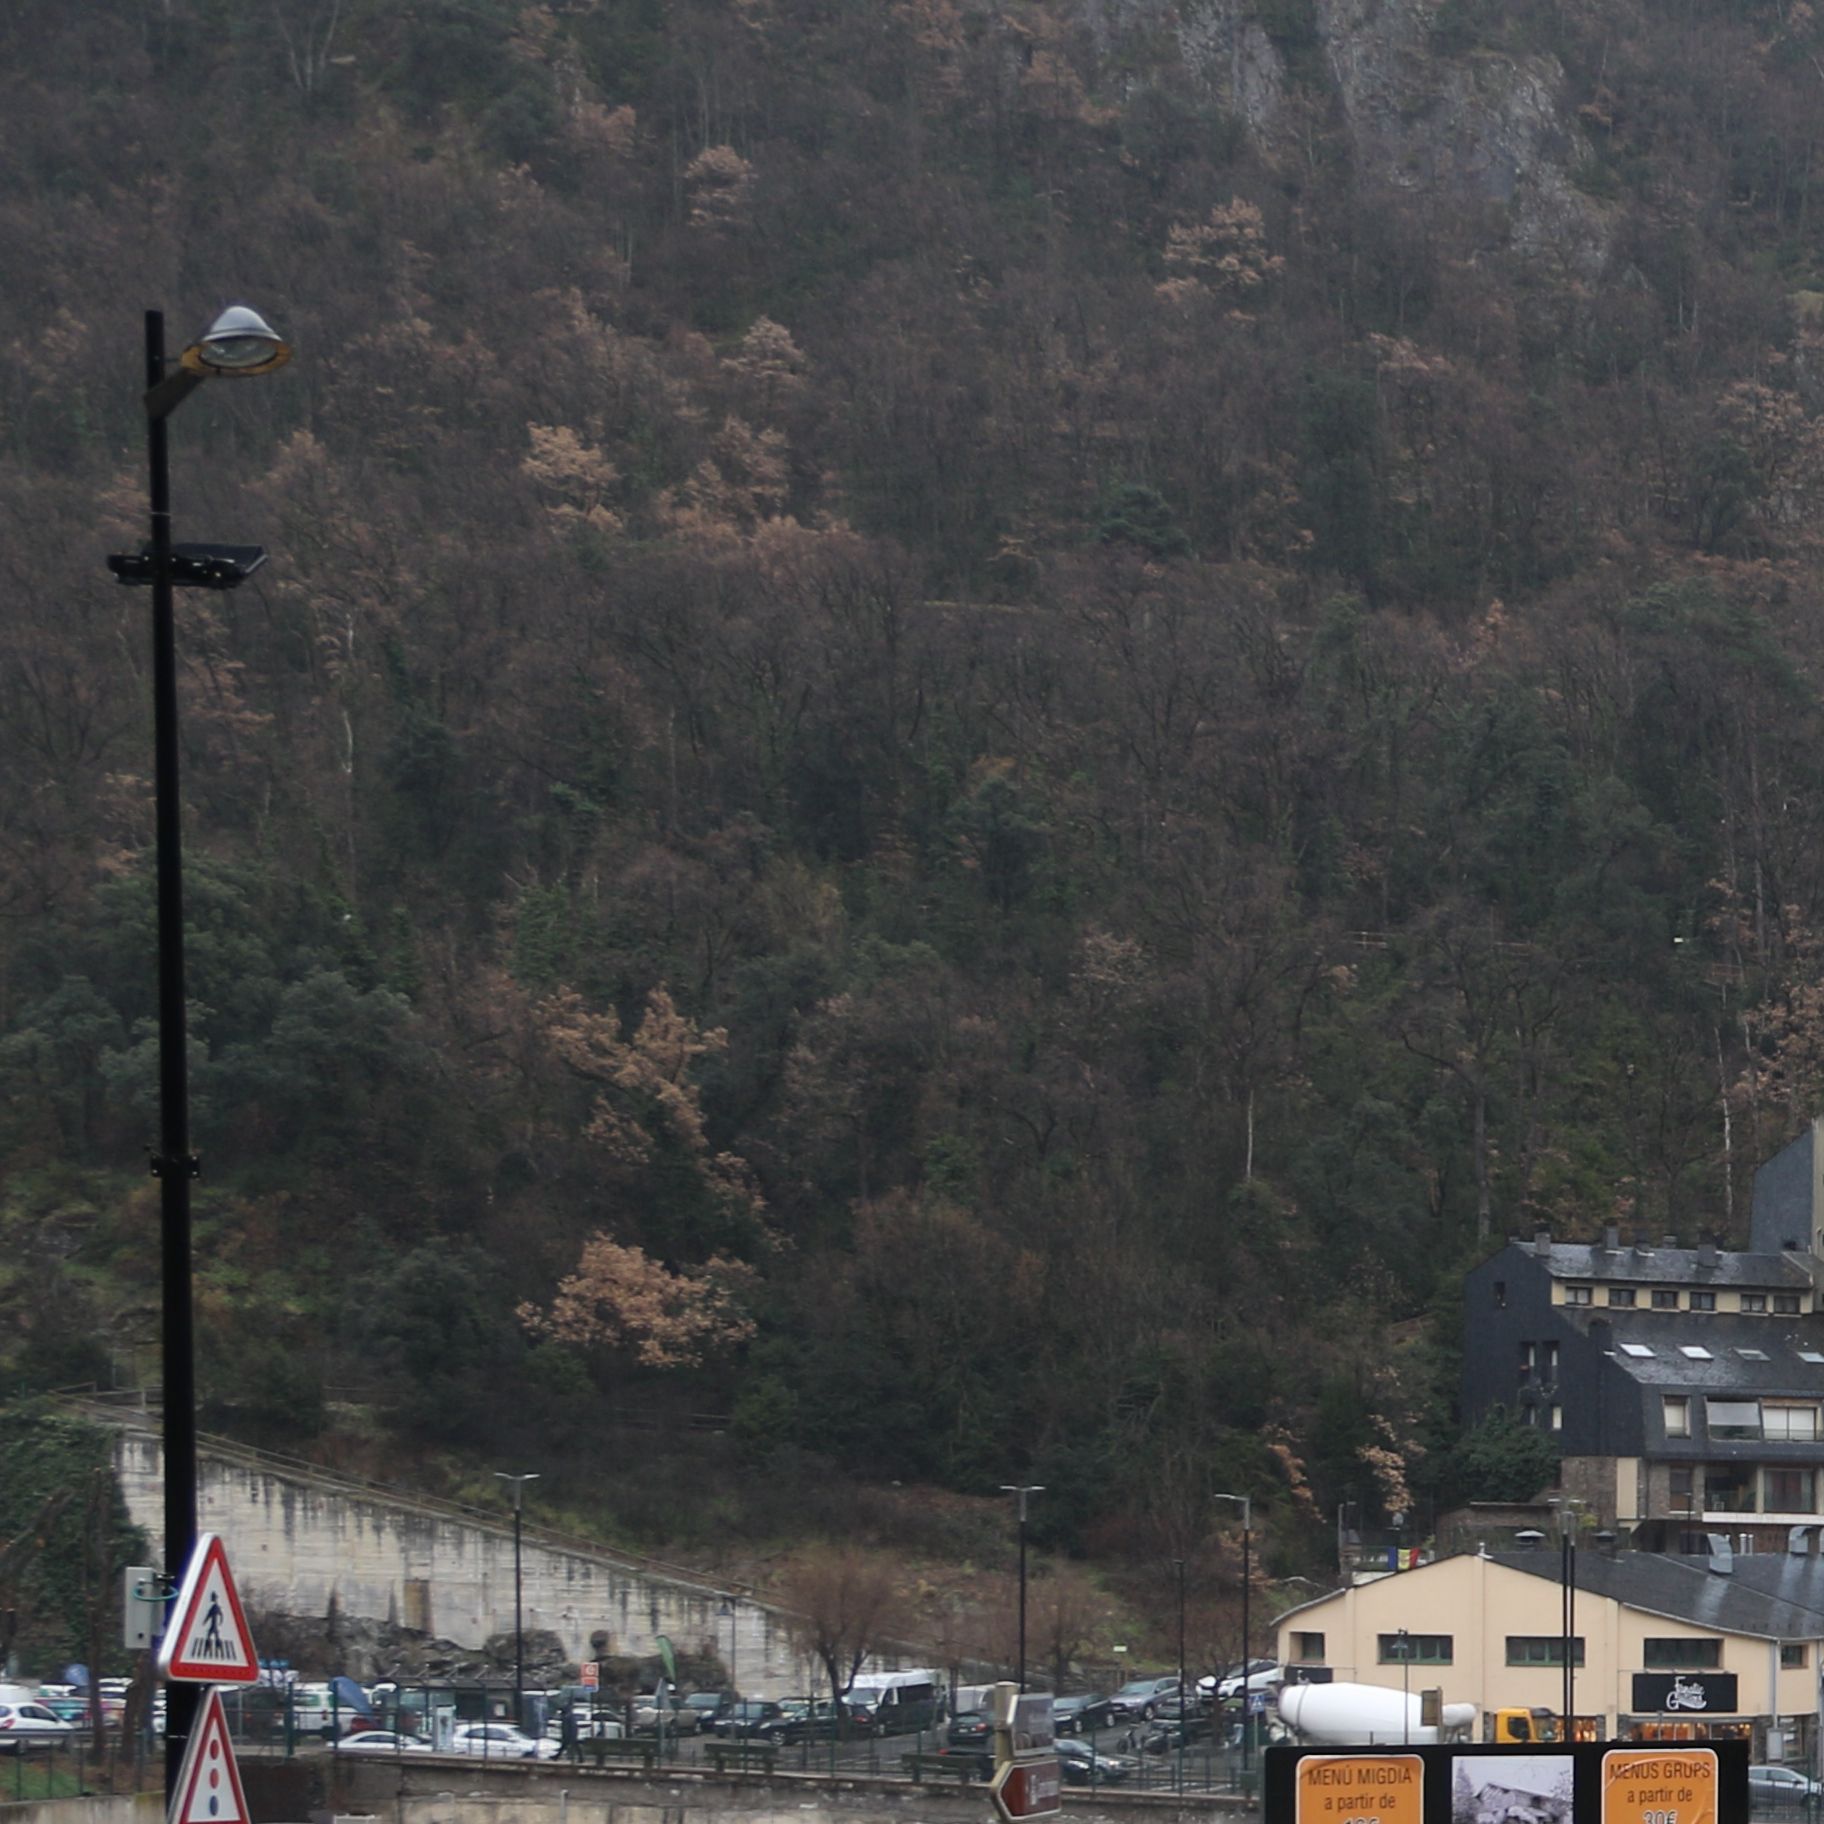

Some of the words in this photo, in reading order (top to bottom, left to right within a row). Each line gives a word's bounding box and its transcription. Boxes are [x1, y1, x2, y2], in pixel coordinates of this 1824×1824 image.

[1357, 1766, 1413, 1785] MIGDIA
[1663, 1761, 1711, 1779] GRUPS
[1324, 1796, 1332, 1810] a
[1336, 1792, 1375, 1812] partir
[1379, 1792, 1397, 1809] de
[1627, 1790, 1635, 1803] a
[1639, 1787, 1674, 1806] partir
[1677, 1786, 1693, 1801] de
